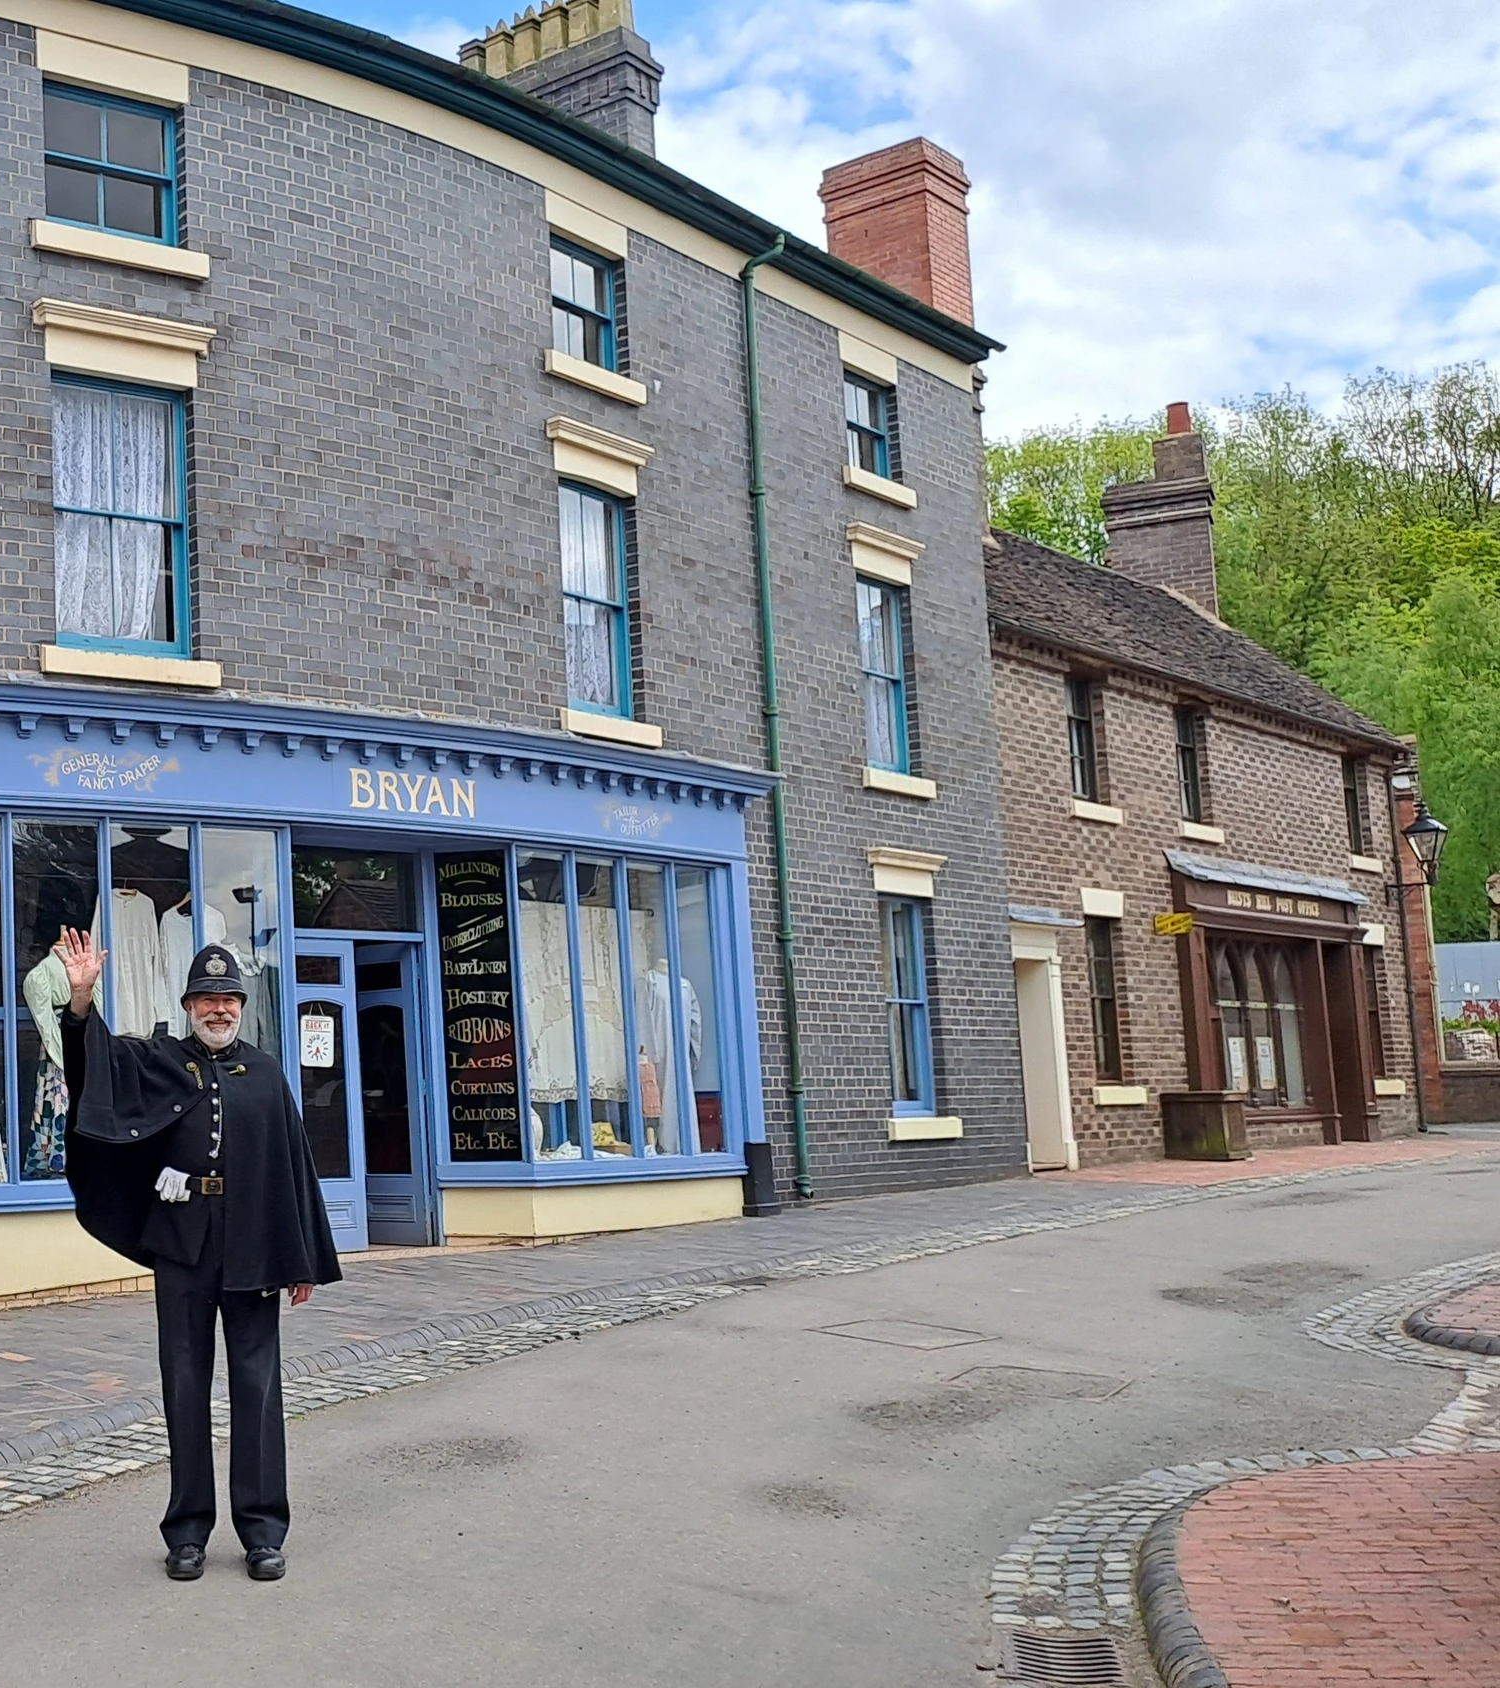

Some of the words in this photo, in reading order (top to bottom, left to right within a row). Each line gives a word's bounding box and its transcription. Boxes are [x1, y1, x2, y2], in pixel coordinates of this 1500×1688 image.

[61, 752, 117, 775] GENERAL
[77, 774, 116, 790] FANCY
[119, 754, 162, 787] DRAPER
[349, 767, 476, 819] BRYAN
[613, 804, 638, 820] TAILOR
[438, 861, 501, 881] MILLINERY
[441, 892, 504, 908] BLOUSES
[1276, 896, 1294, 915] POST
[447, 1017, 512, 1044] RIBBONS
[449, 1051, 514, 1069] LACES
[451, 1080, 516, 1095] CURTAINS
[452, 1105, 517, 1121] CALICOES
